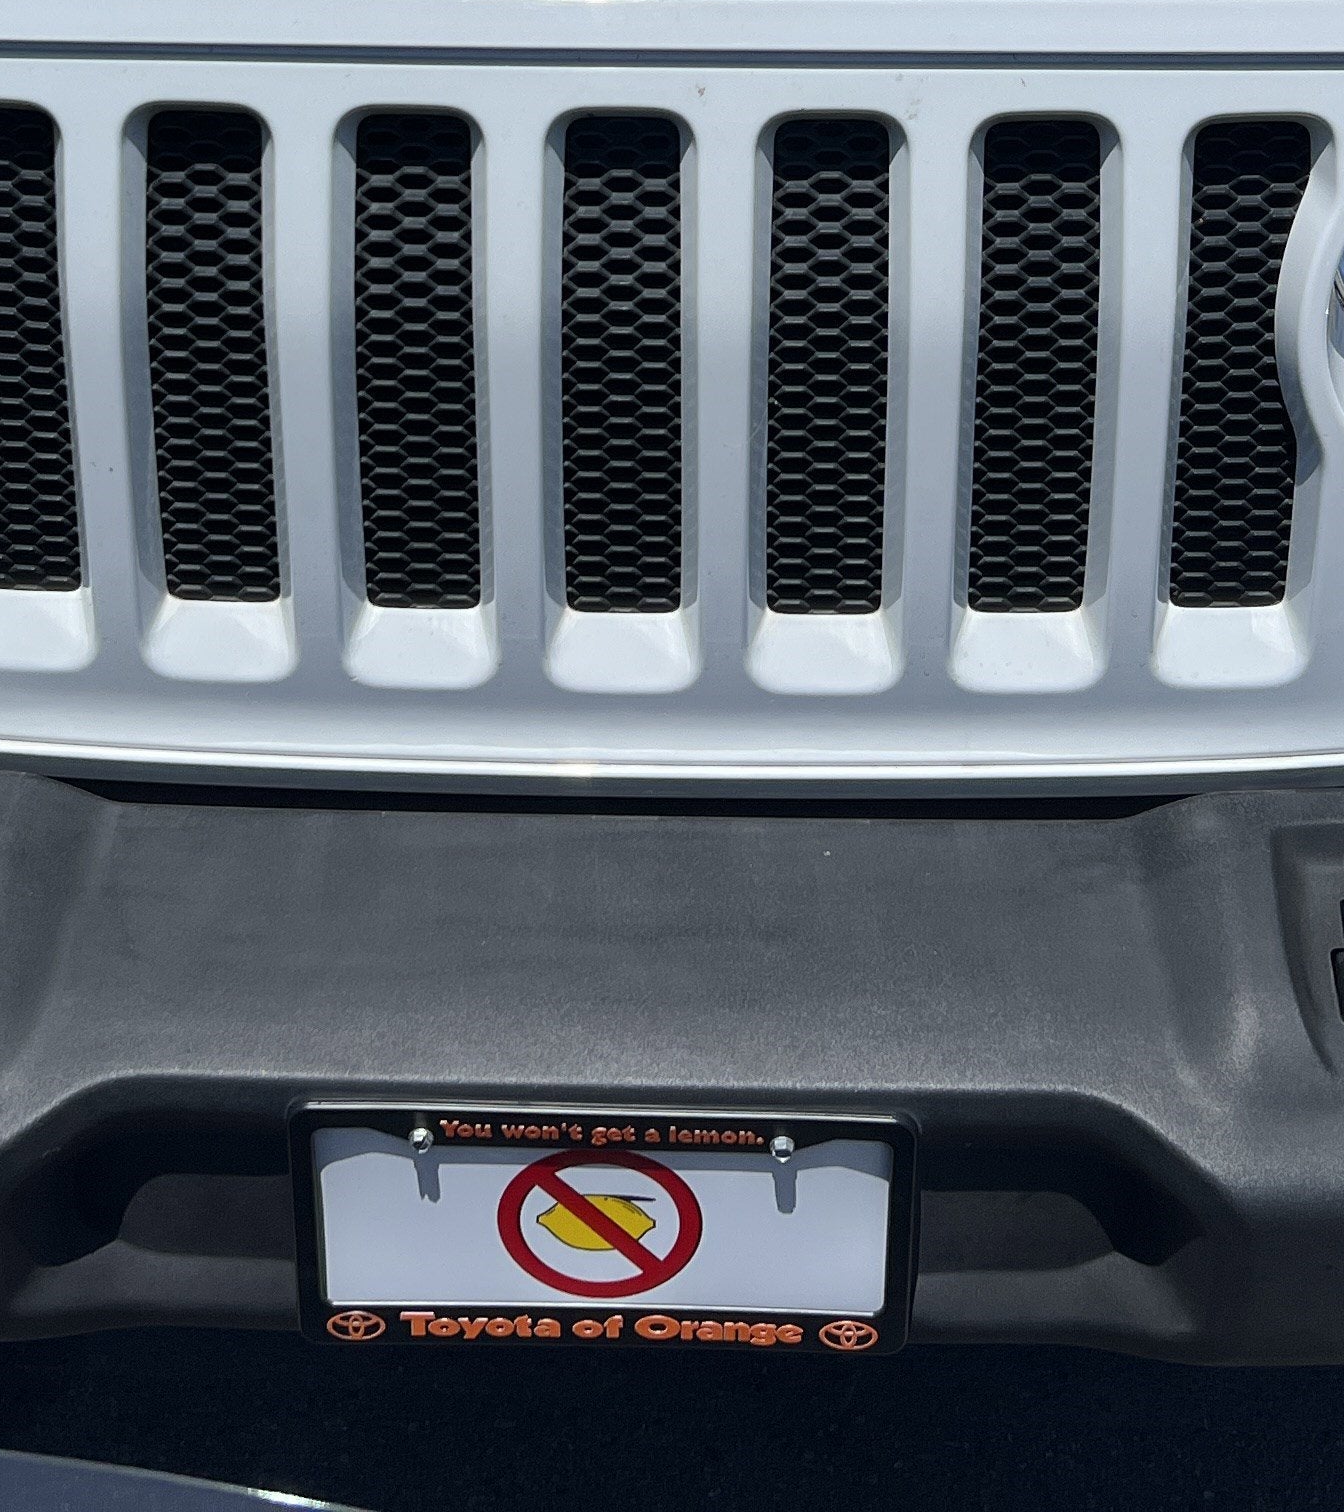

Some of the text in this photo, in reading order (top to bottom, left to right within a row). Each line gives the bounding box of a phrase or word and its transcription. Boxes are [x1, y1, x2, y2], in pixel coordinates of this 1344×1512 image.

[440, 1120, 764, 1147] You won't get a lemon.
[400, 1311, 804, 1346] Toyota of Orange
